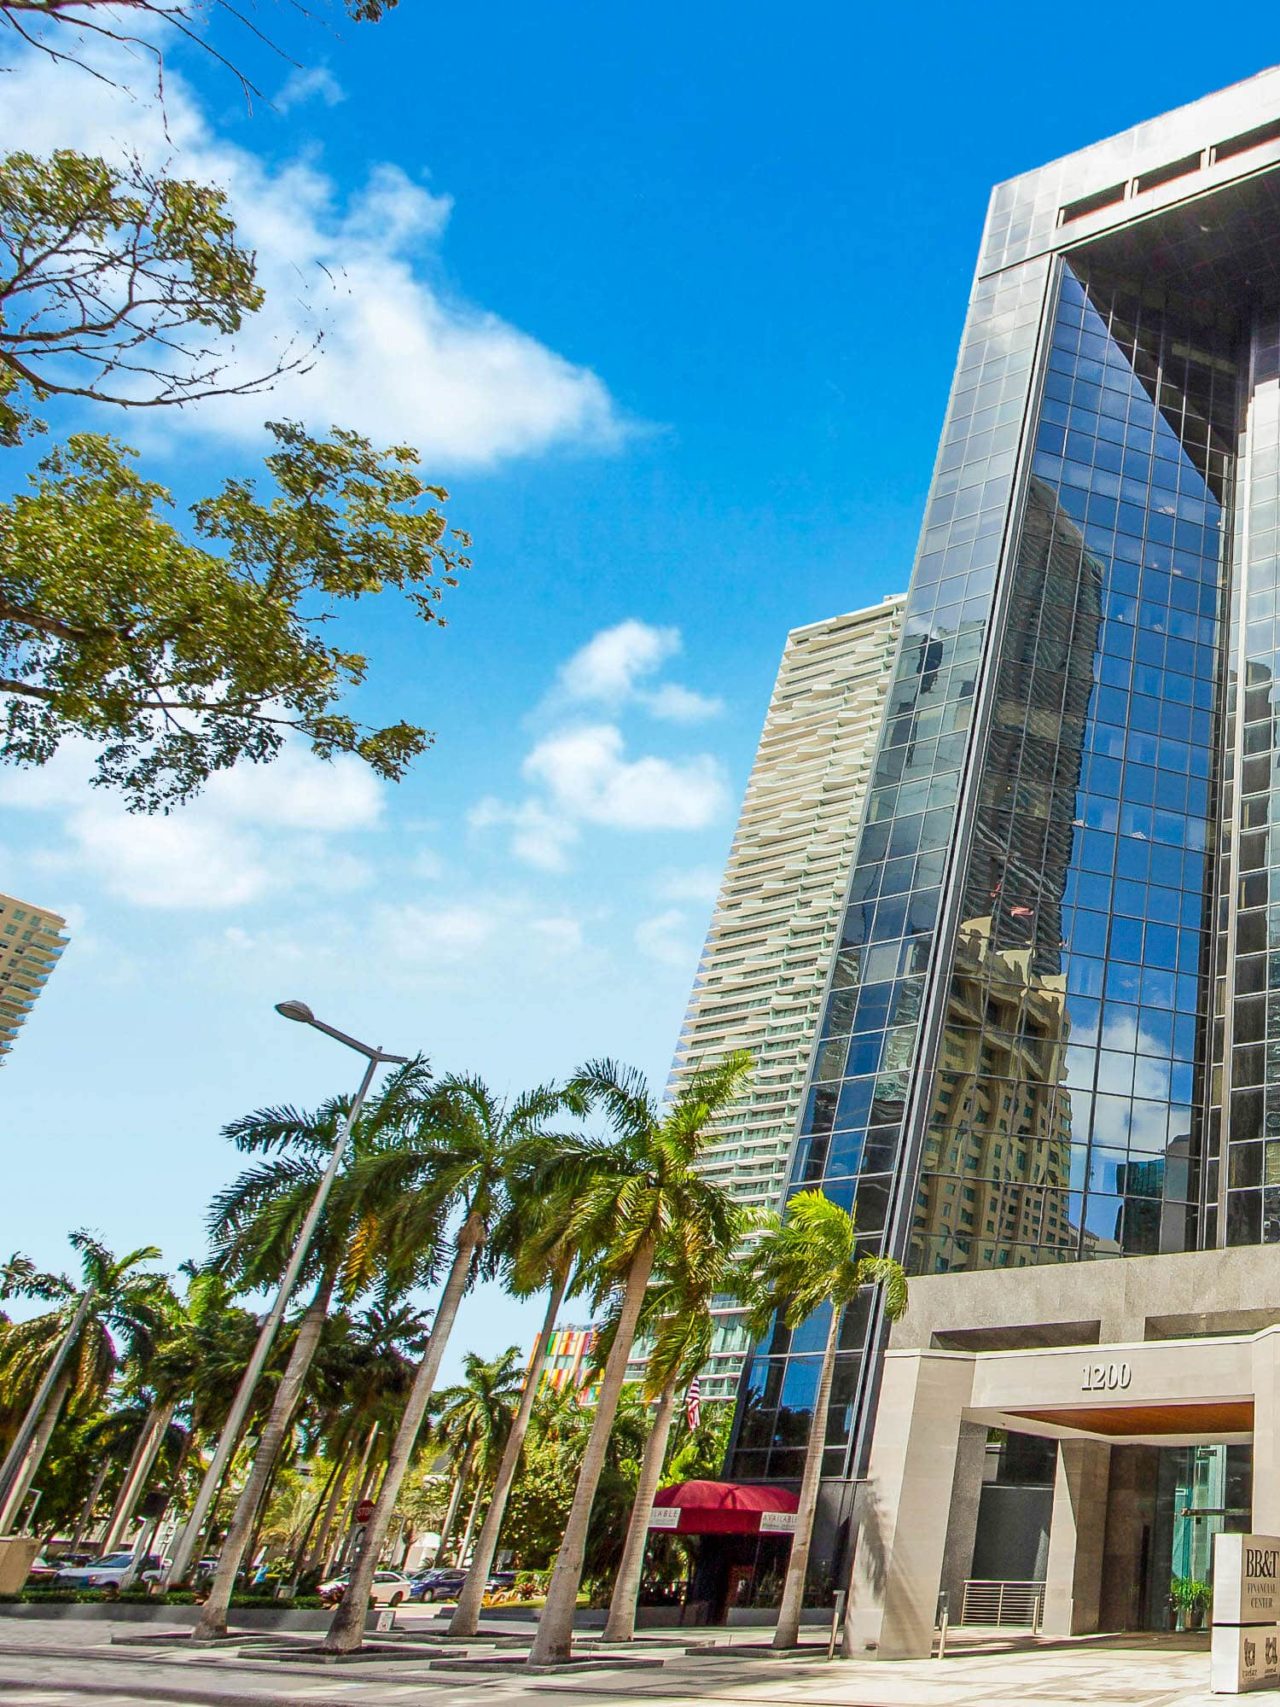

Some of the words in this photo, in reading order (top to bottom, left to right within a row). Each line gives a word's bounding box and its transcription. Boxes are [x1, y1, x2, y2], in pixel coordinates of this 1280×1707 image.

[1081, 1363, 1132, 1392] 1200
[1246, 1549, 1280, 1578] BB&T
[1247, 1583, 1277, 1594] FINANCIAL
[1250, 1597, 1273, 1609] CENTER
